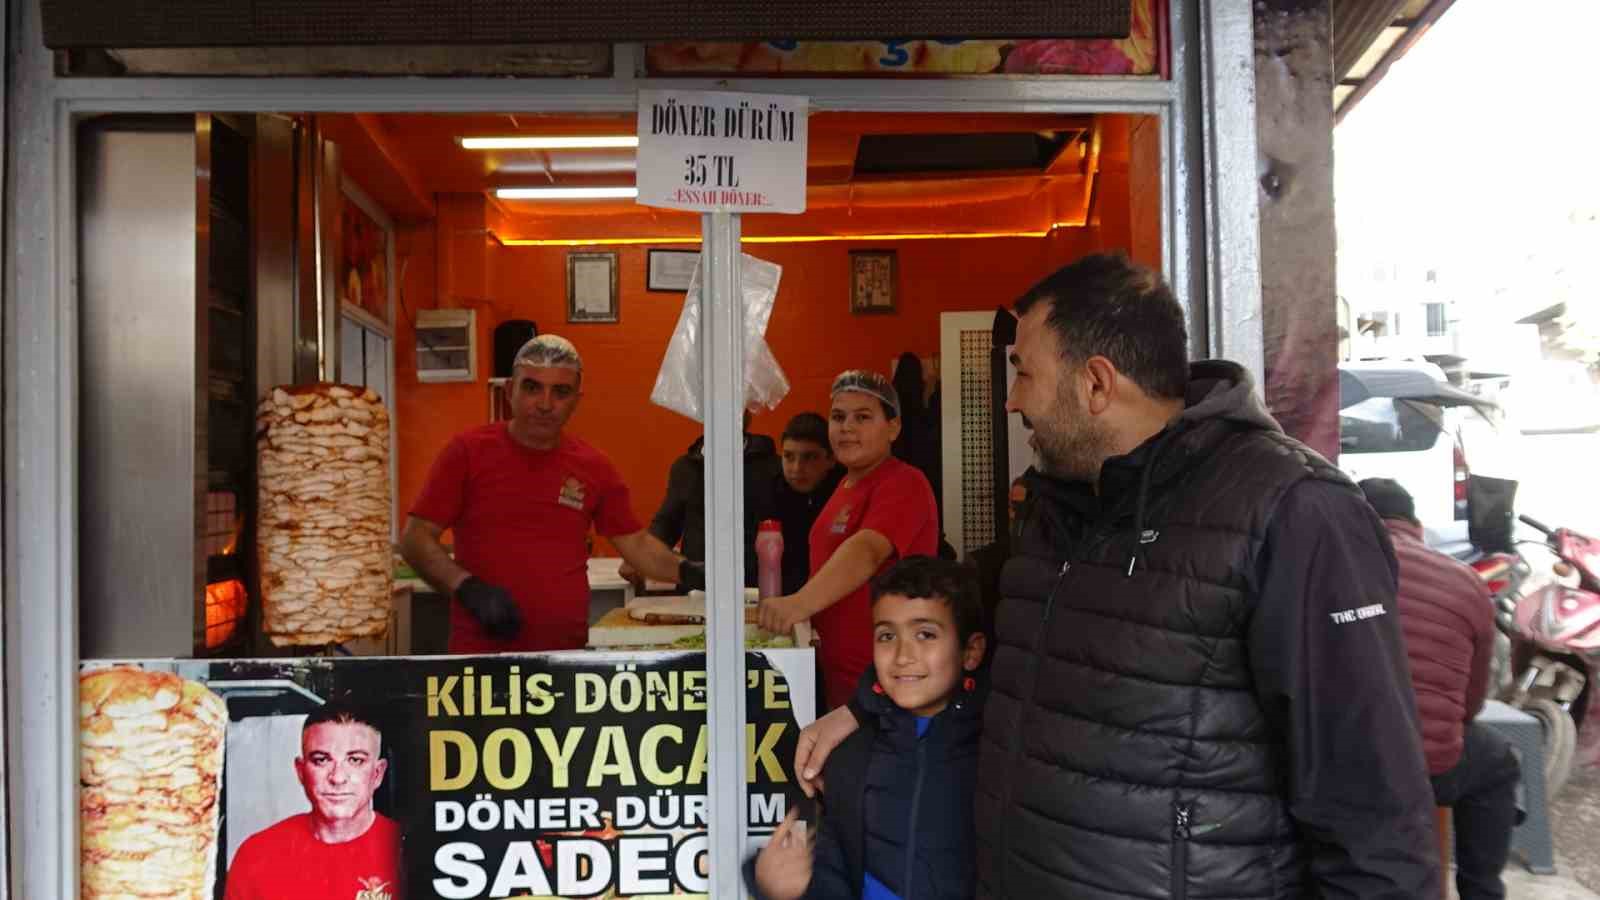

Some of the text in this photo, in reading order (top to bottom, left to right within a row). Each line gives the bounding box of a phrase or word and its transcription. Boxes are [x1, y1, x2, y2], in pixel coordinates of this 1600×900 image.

[651, 99, 795, 142] DÖNER DÜRÜM
[684, 155, 739, 188] 35 TL
[427, 664, 790, 717] KİLİS DÖNE'E
[435, 789, 786, 832] DÖNER DÜRM
